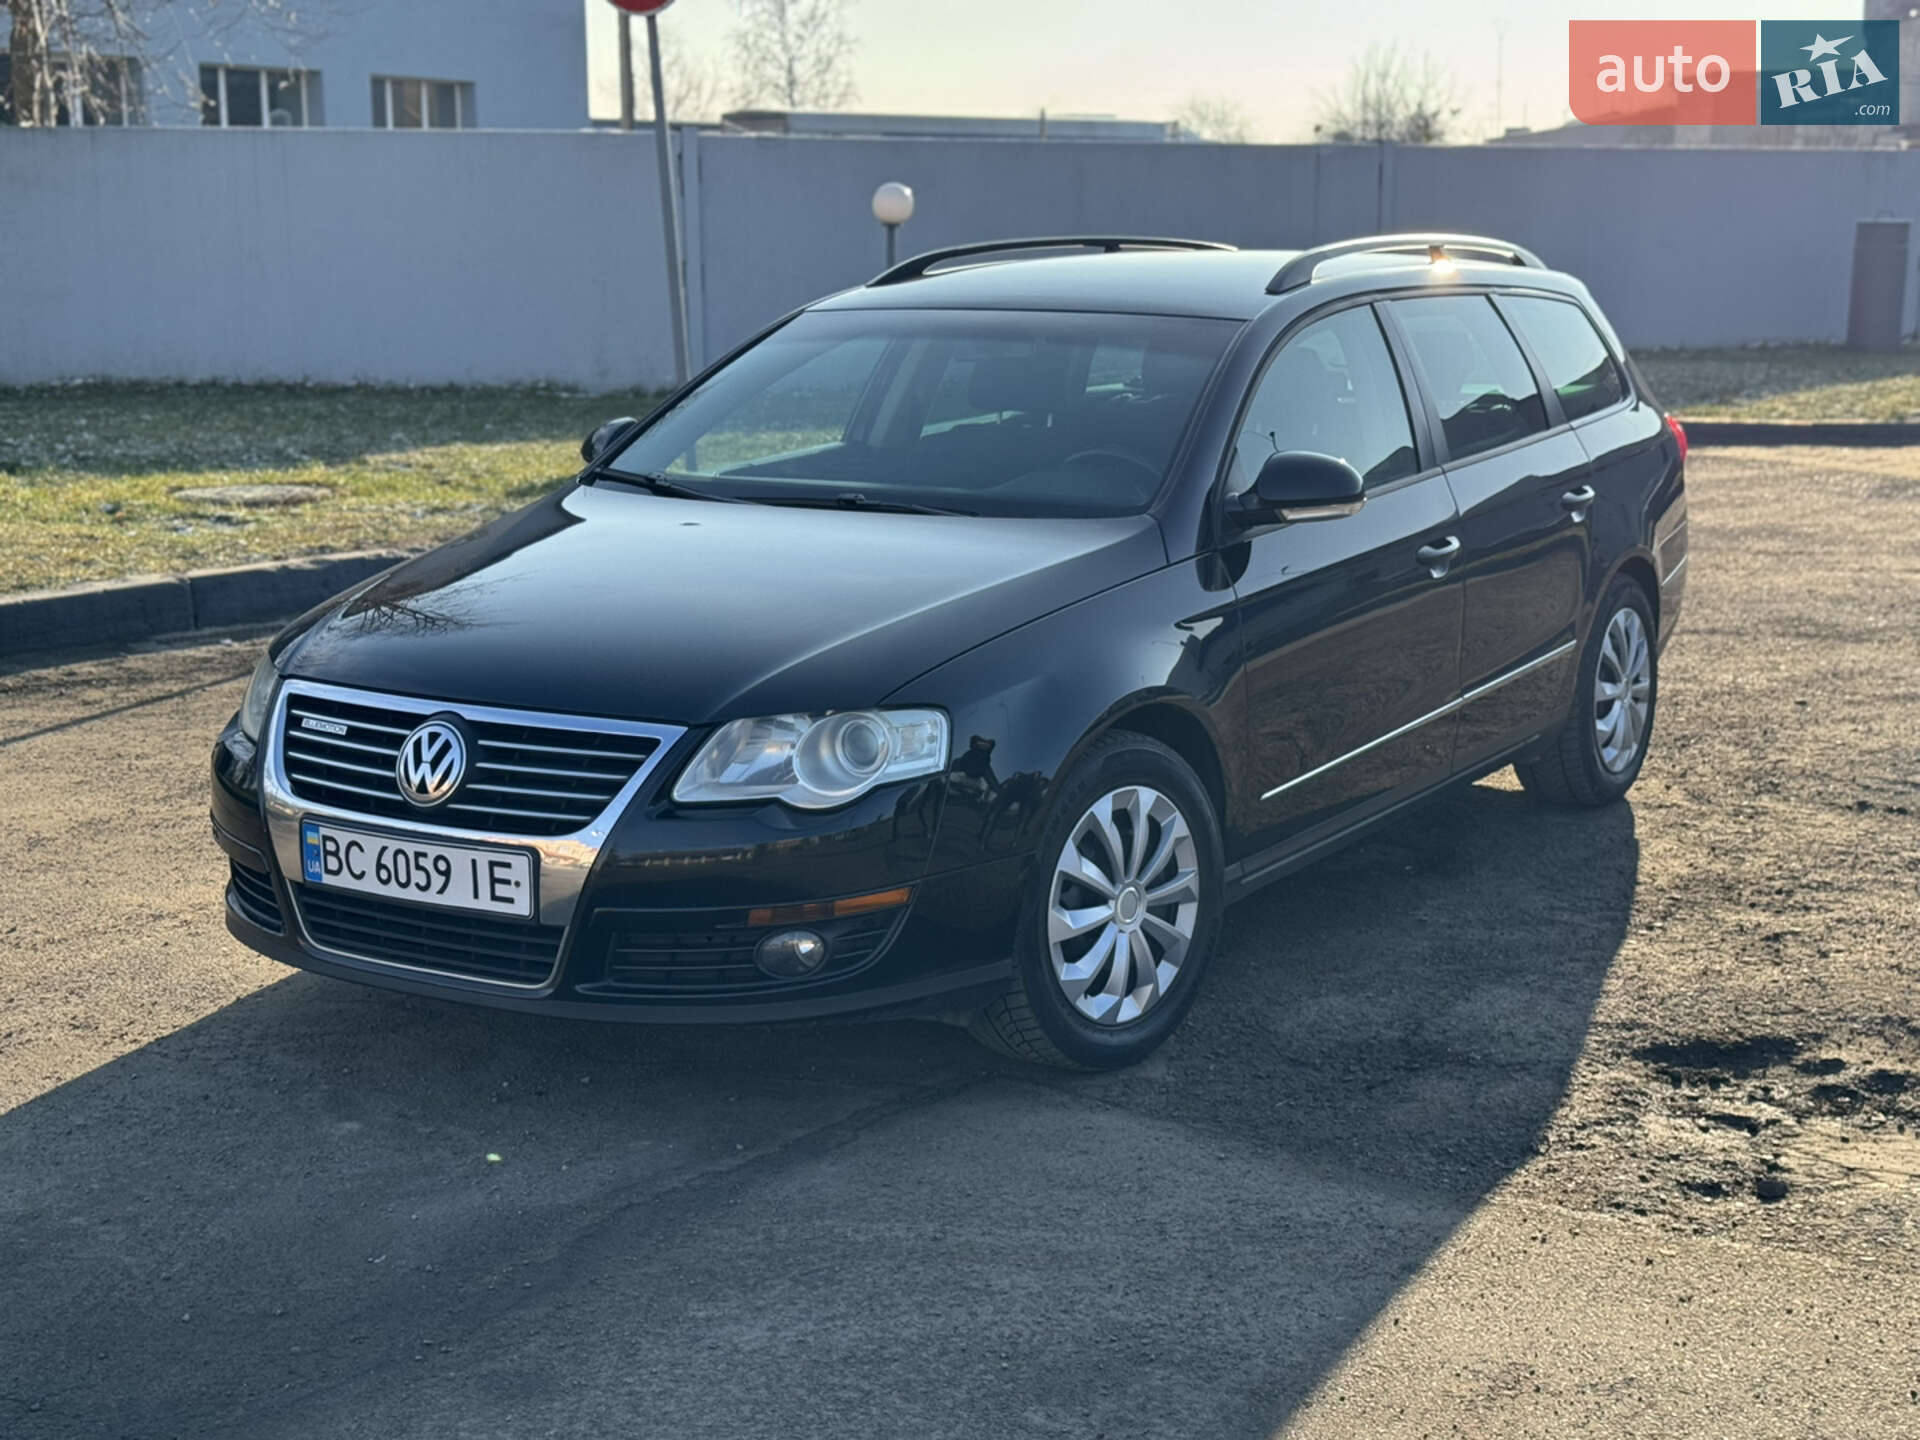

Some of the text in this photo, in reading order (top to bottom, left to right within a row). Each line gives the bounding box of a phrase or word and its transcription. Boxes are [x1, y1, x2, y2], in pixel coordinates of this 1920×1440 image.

[306, 859, 321, 874] UA
[321, 834, 516, 905] BC 6059 IE
